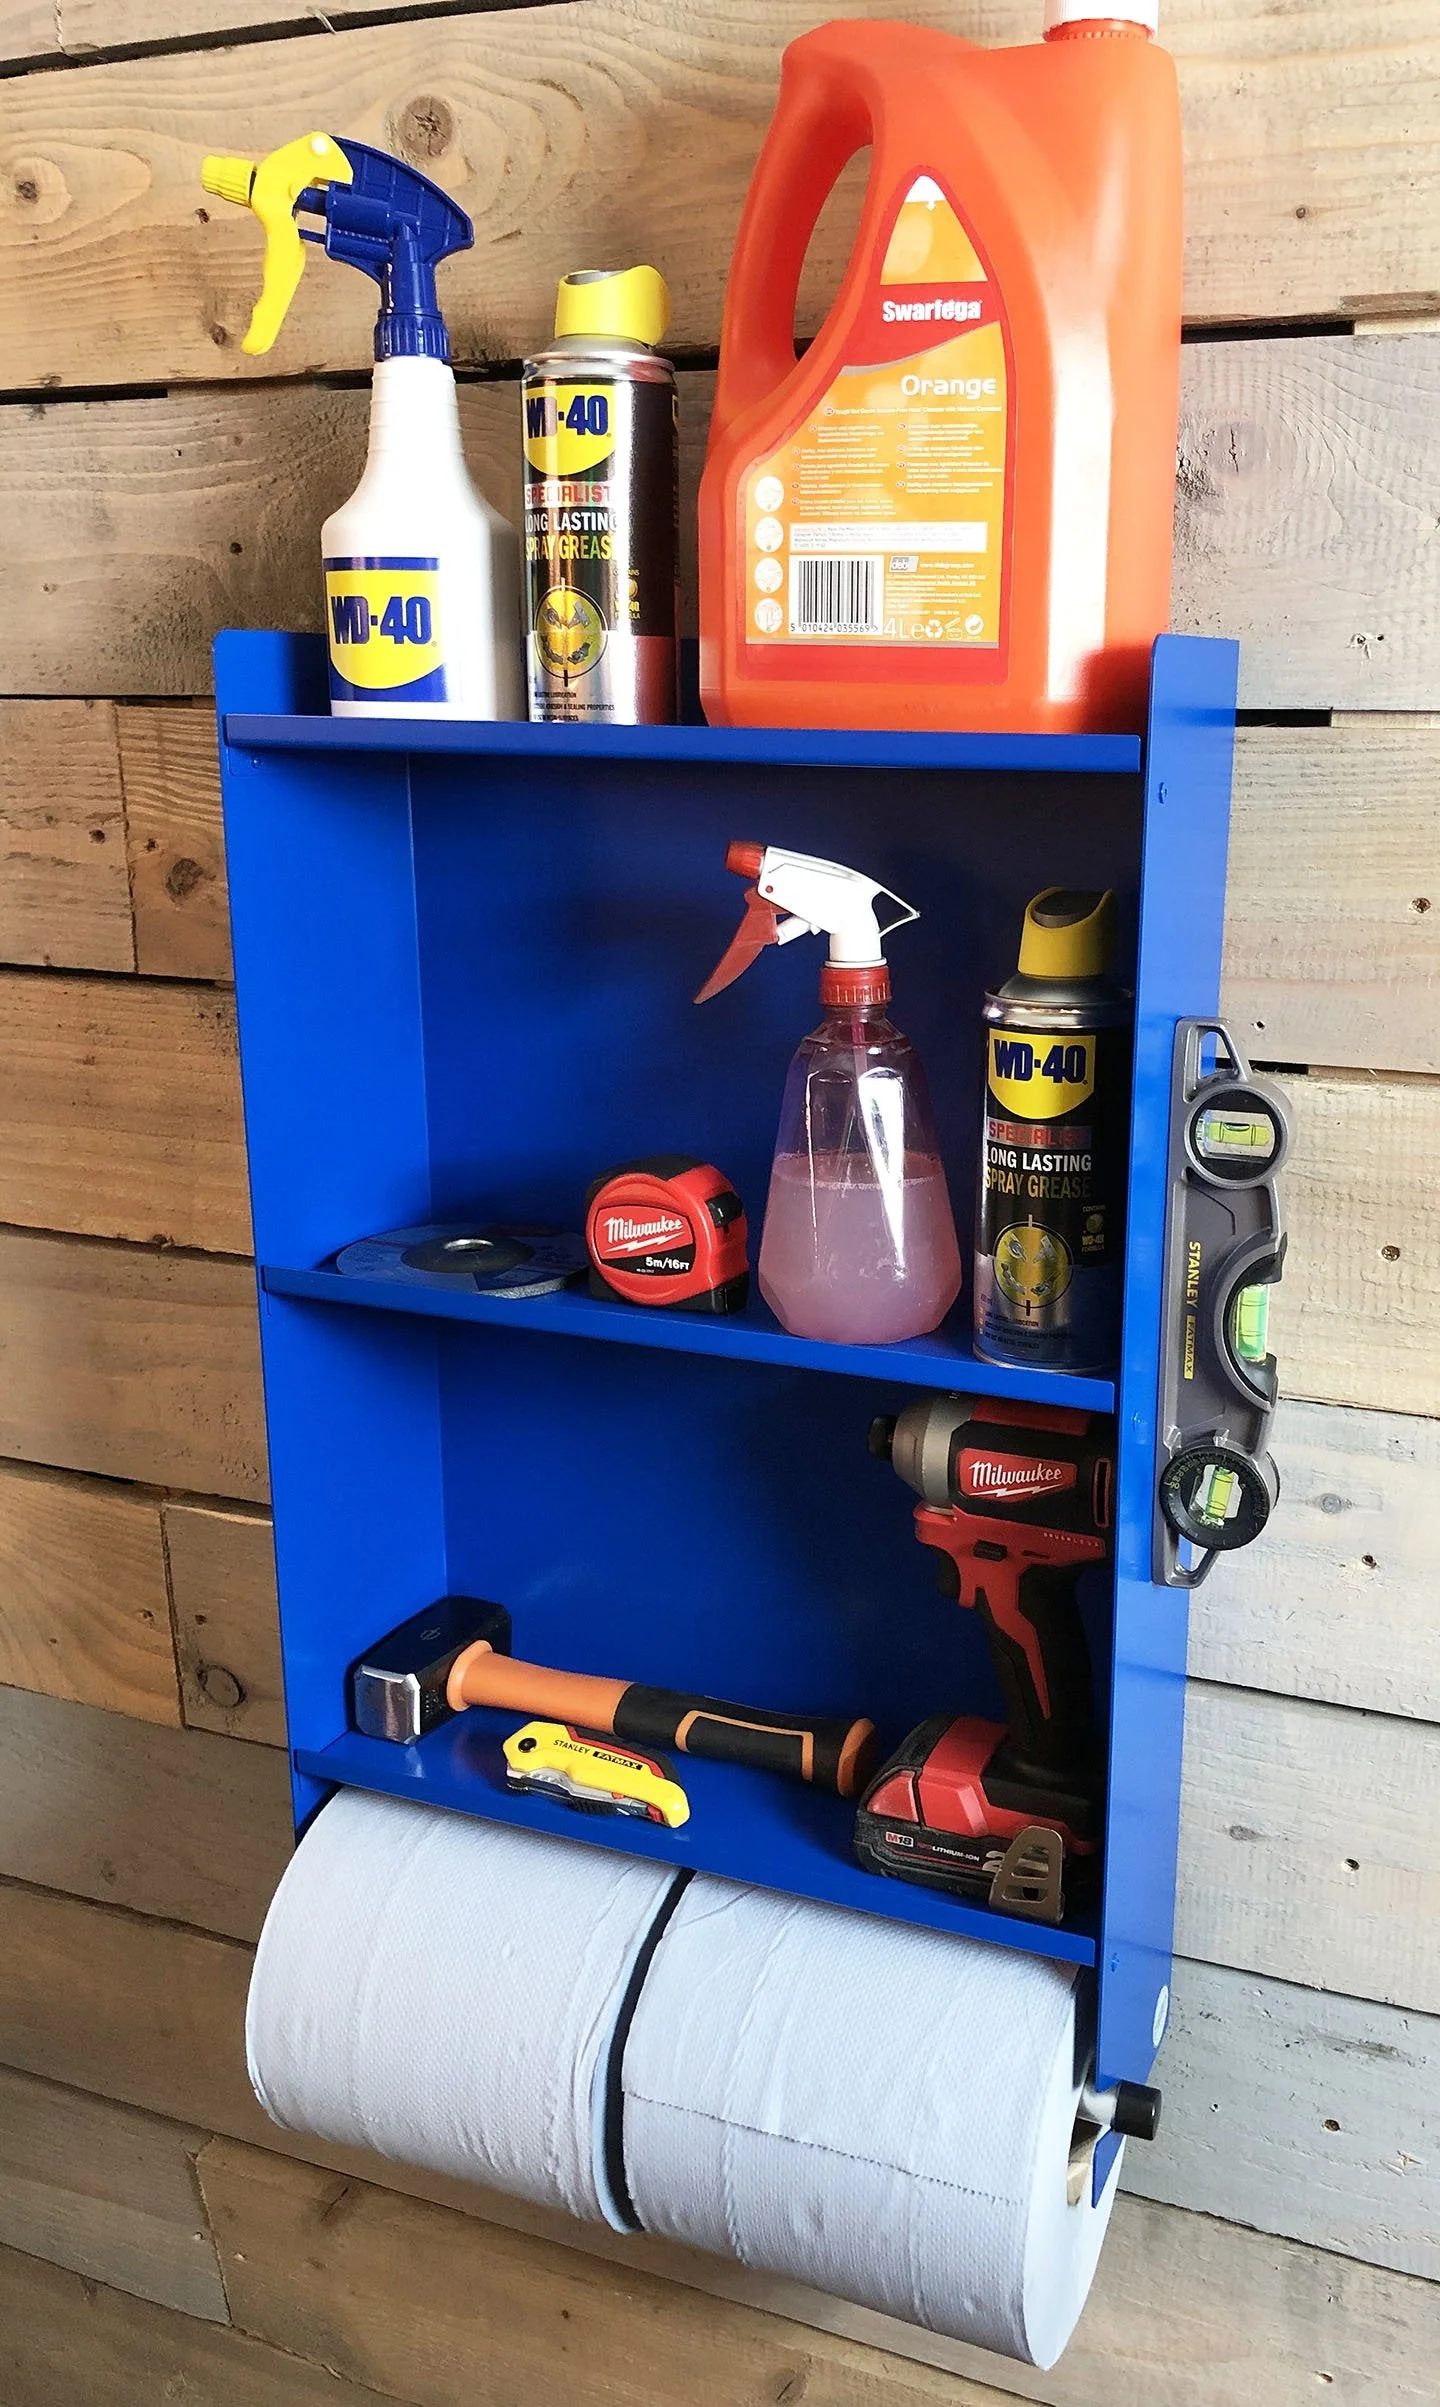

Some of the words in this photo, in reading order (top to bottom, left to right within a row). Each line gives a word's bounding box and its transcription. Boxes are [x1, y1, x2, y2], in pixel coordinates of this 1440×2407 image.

[882, 299, 980, 323] Swarfega
[900, 374, 996, 400] Orange
[525, 394, 609, 439] WD-40
[526, 484, 611, 503] SPECIALIST
[525, 513, 549, 532] LONG
[525, 534, 556, 561] SPRAY
[558, 535, 617, 561] GREAS
[330, 595, 431, 645] WD-40
[994, 1038, 1087, 1084] WD-40
[988, 1122, 1087, 1147] SPECIALIST
[986, 1144, 1018, 1169] LONG
[1022, 1152, 1092, 1173] LASTING
[985, 1167, 1024, 1196] SPRAY
[1027, 1174, 1092, 1200] GREASE
[602, 1215, 684, 1243] Milwaukee
[1186, 1240, 1201, 1309] STANLEY
[1184, 1320, 1195, 1375] FATMAX
[968, 1458, 1064, 1489] Milwaukee
[553, 1739, 591, 1754] STANLEY
[596, 1751, 640, 1770] FATMAX
[887, 1833, 912, 1846] M18
